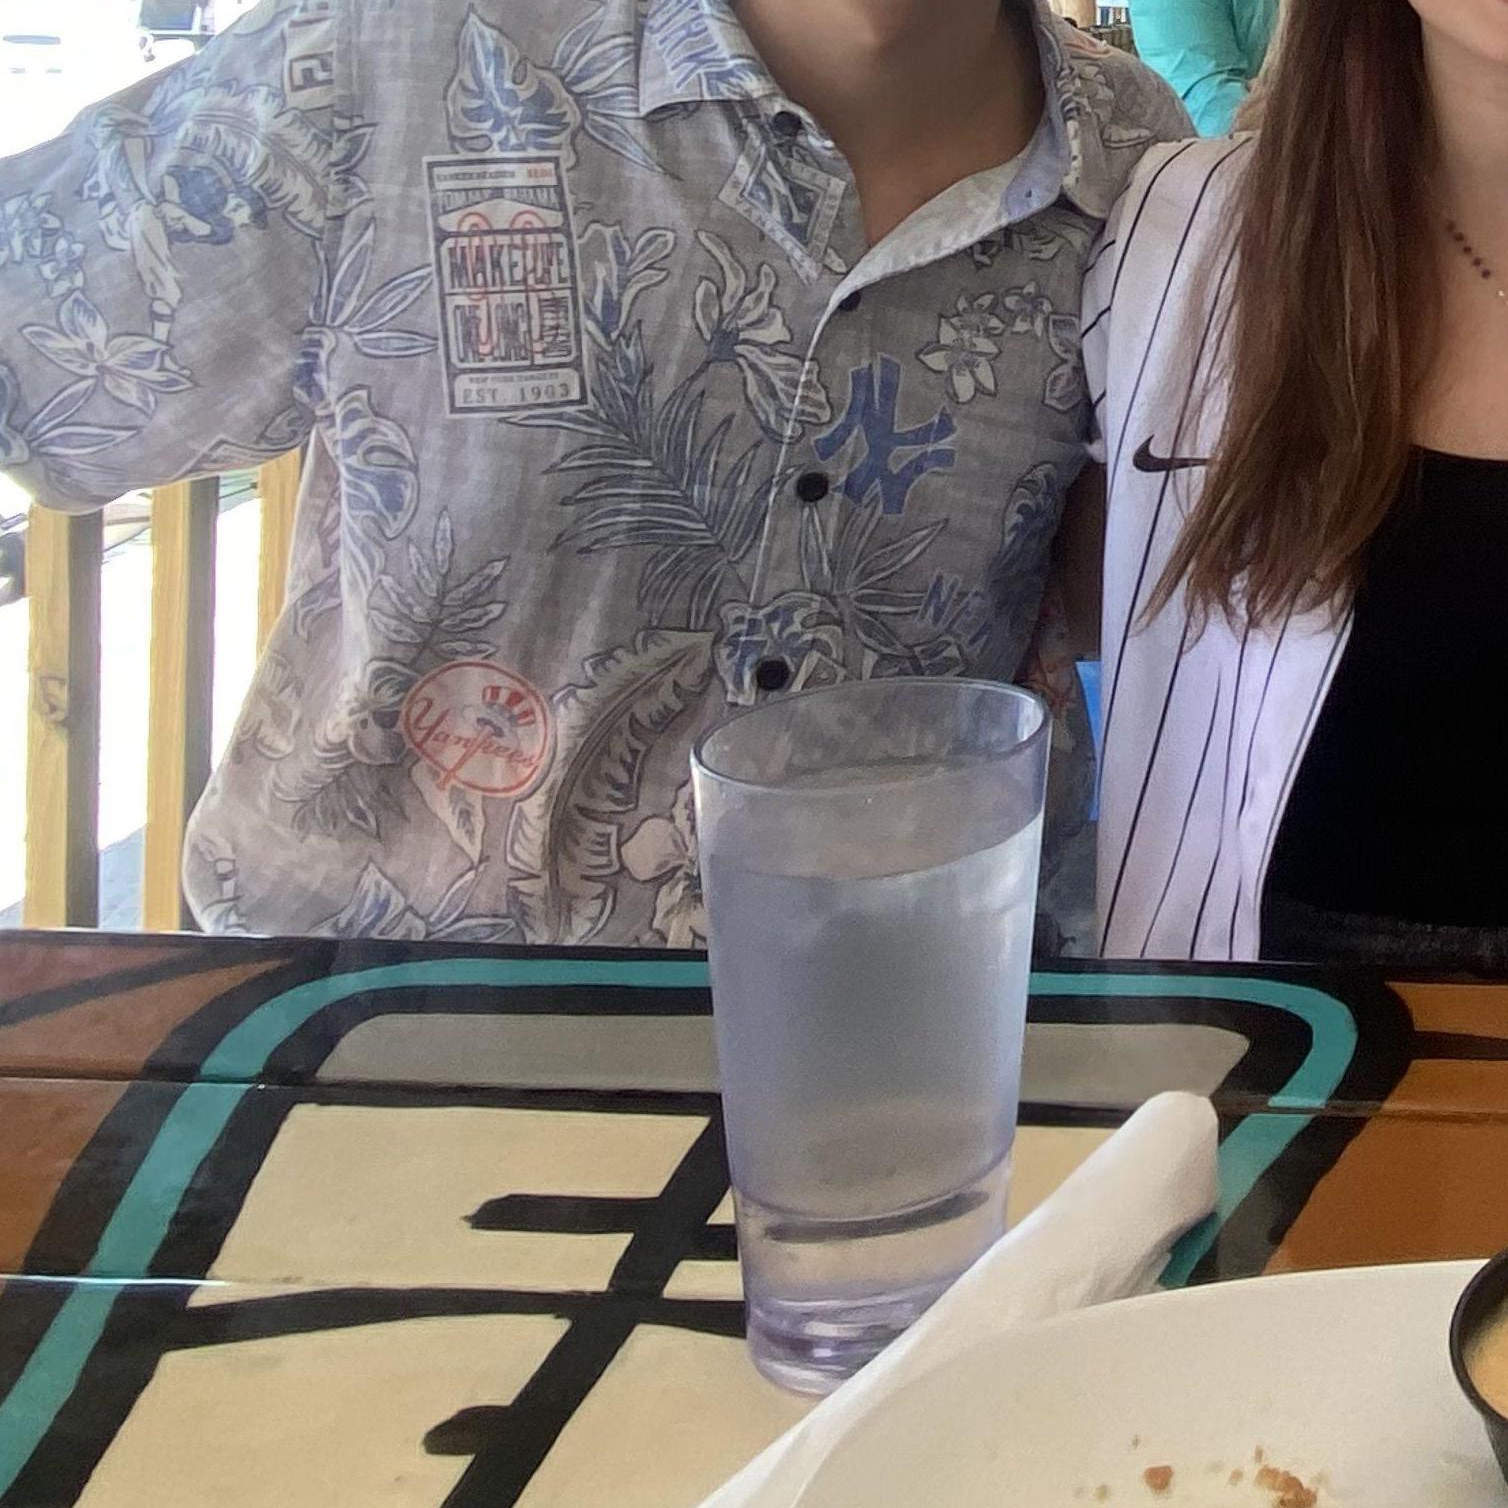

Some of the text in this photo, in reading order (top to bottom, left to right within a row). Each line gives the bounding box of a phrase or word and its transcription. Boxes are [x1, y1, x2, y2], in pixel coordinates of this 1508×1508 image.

[448, 244, 522, 289] MAKE
[463, 383, 571, 404] EST. 1903
[412, 696, 539, 768] Yankees
